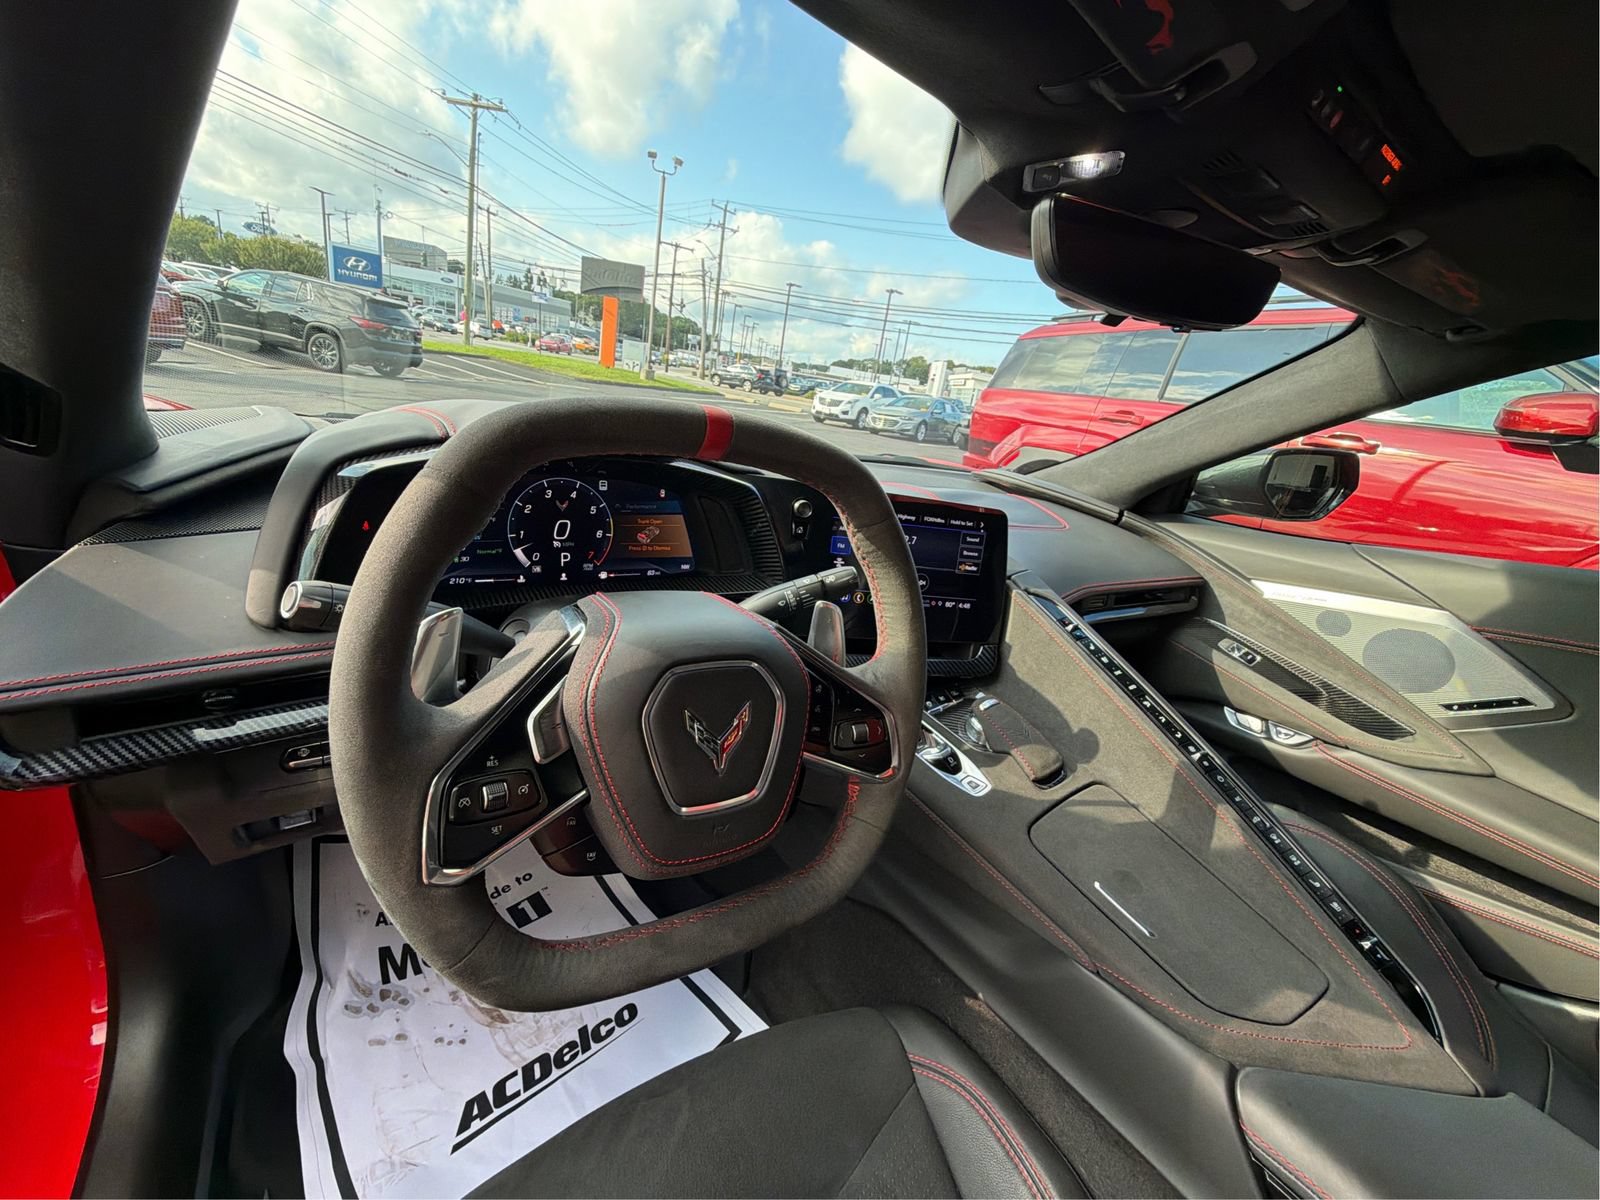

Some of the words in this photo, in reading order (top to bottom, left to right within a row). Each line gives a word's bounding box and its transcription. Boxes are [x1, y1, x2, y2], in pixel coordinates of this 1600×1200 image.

[336, 268, 378, 282] HYUNDAI
[545, 490, 552, 498] 3
[524, 505, 532, 513] 2
[590, 506, 597, 514] 5
[554, 520, 571, 540] 0
[596, 530, 603, 538] 6
[520, 531, 524, 539] 1
[532, 553, 540, 561] 0
[588, 551, 594, 559] 7
[561, 553, 570, 567] P
[486, 759, 499, 767] RES
[491, 825, 502, 833] SET
[515, 873, 533, 886] to
[455, 1002, 638, 1137] ACDelco
